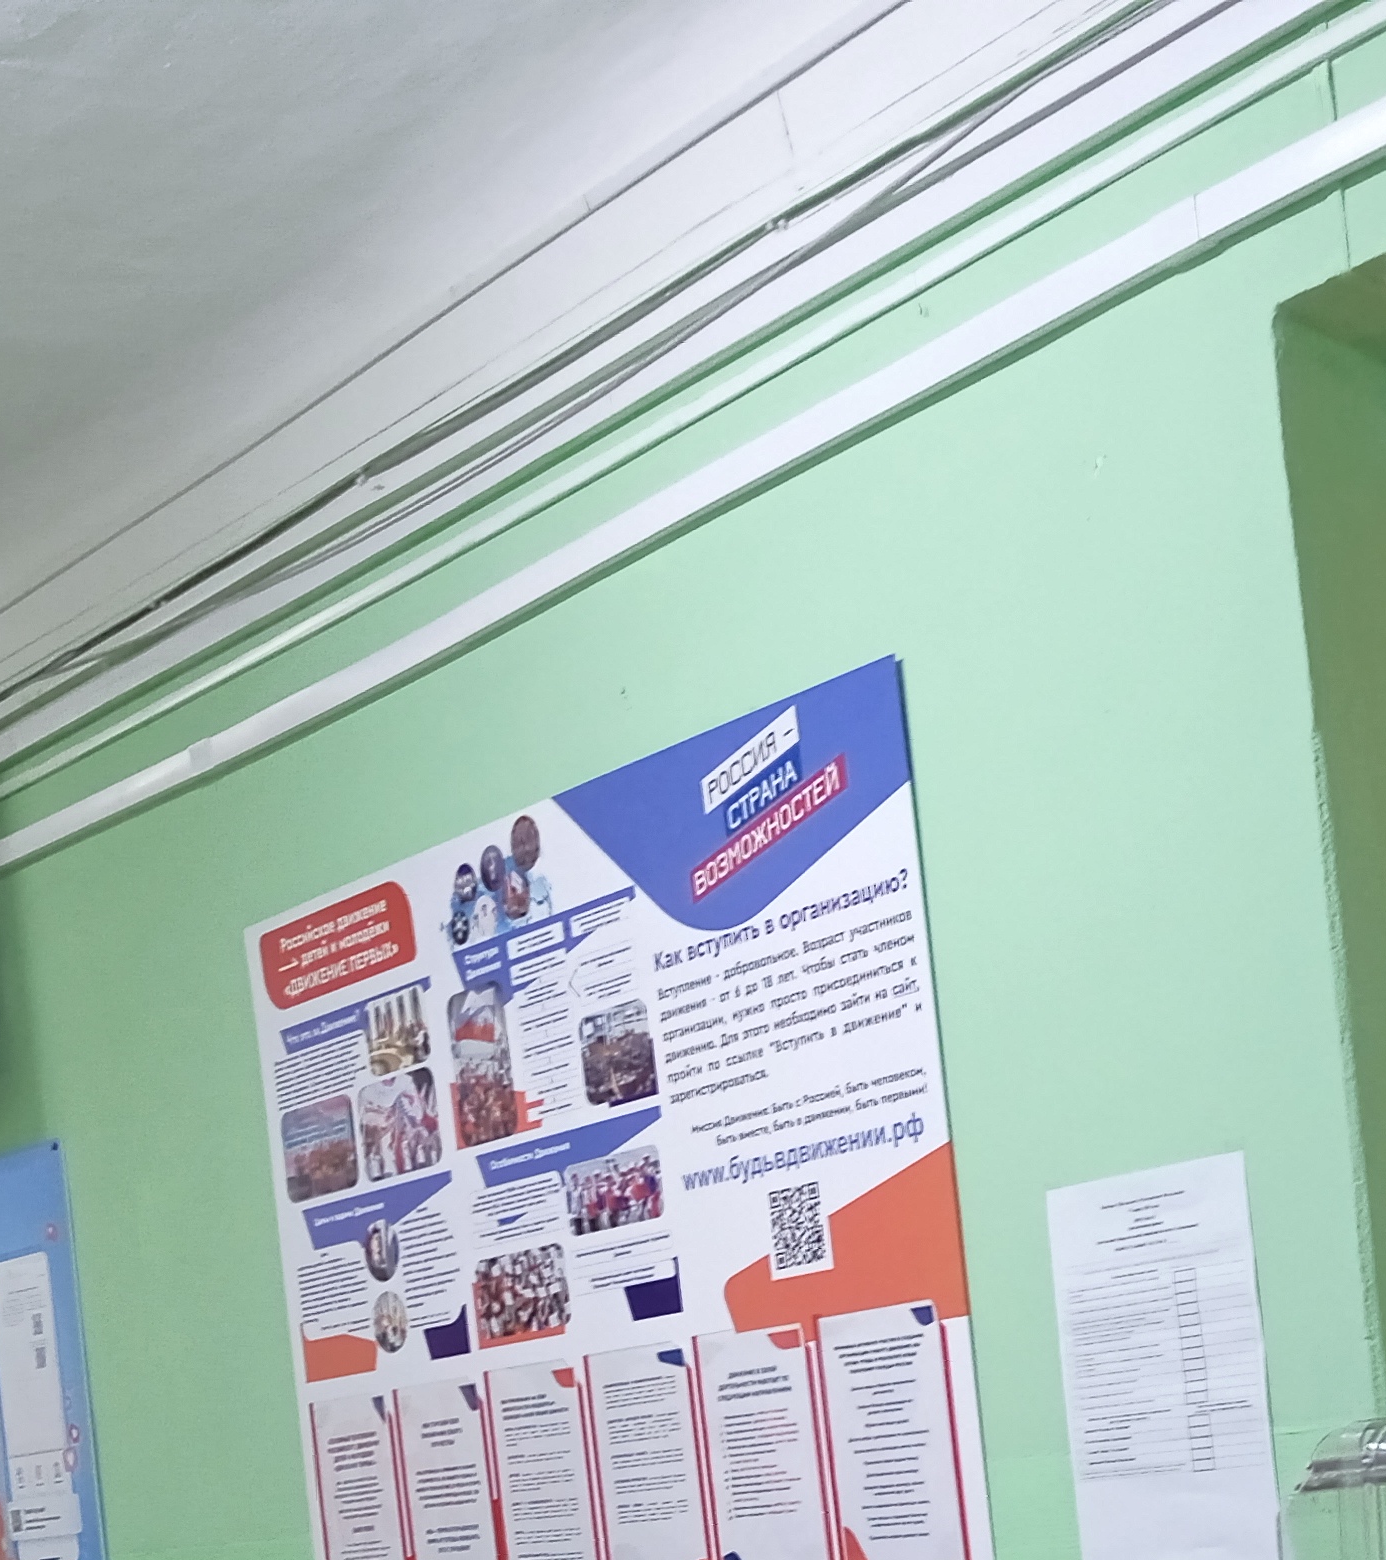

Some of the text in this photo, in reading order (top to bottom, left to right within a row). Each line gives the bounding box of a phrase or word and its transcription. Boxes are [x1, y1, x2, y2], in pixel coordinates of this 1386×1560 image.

[707, 731, 777, 804] РОССИЯ
[727, 760, 798, 830] СТРАНА
[693, 761, 840, 896] ВОЗМОЖНОСТЕЙ
[654, 868, 908, 971] Как вступить в организацию?
[657, 971, 712, 1001] Вступление
[803, 930, 845, 954] Возраст
[849, 910, 912, 943] участников
[802, 957, 835, 976] Чтобы
[840, 948, 869, 965] стать
[733, 1002, 765, 1022] нужно
[770, 990, 807, 1010] просто
[682, 1112, 925, 1191] www.будьвдвижении.рф
